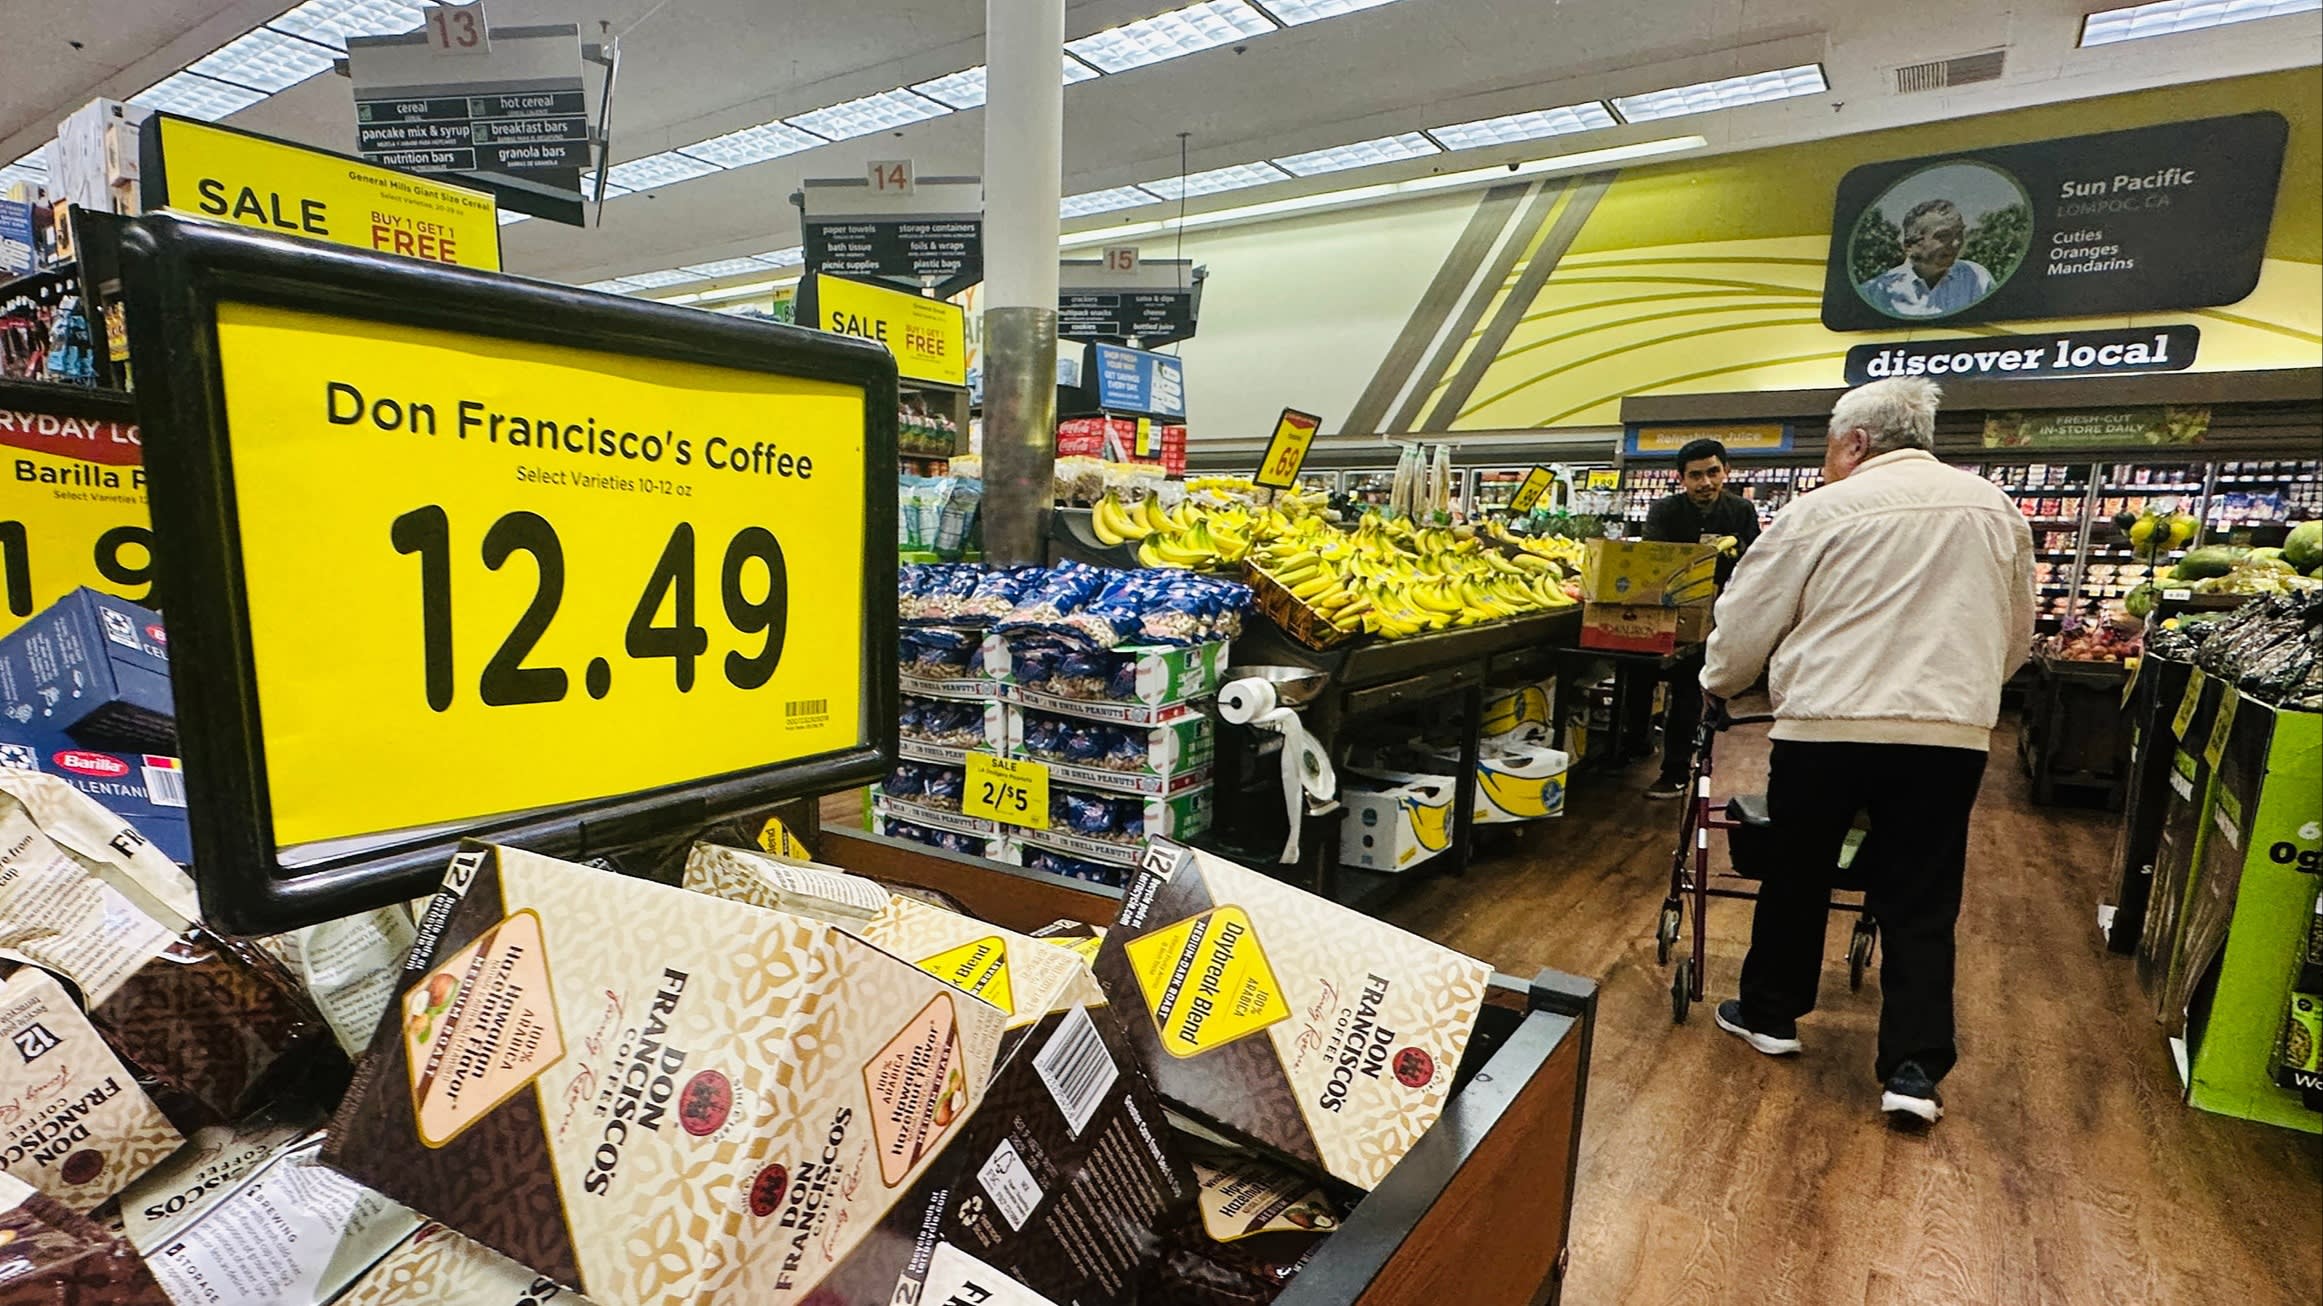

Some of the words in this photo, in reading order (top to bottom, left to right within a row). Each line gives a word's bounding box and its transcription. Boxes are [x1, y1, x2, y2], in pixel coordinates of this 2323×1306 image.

[433, 10, 479, 49] 13
[396, 101, 428, 114] cereal
[500, 96, 519, 109] hot
[521, 94, 555, 108] cereal
[362, 128, 405, 143] pancake
[407, 126, 428, 138] mix
[430, 126, 439, 137] &
[440, 124, 470, 140] syrup
[491, 121, 542, 136] breakfast
[544, 120, 568, 133] bars
[383, 151, 429, 165] nutrition
[431, 151, 454, 163] bars
[498, 147, 540, 162] granola
[541, 145, 566, 158] bars
[348, 170, 388, 188] General
[390, 178, 412, 193] Mills
[413, 184, 439, 200] Giant
[441, 190, 460, 204] Size
[462, 195, 491, 212] Cereal
[873, 163, 907, 191] 14
[2060, 180, 2107, 200] Sun
[2112, 167, 2197, 194] Pacific
[198, 178, 330, 236] SALE
[2144, 194, 2171, 211] CA
[371, 210, 401, 226] BUY
[406, 218, 413, 230] 1
[417, 219, 447, 235] GET
[449, 227, 455, 239] 1
[932, 223, 975, 232] containers
[2052, 229, 2103, 245] Cuties
[371, 225, 458, 264] FREE
[1107, 250, 1133, 270] 15
[2049, 243, 2119, 262] Oranges
[2046, 257, 2135, 276] Mandarins
[831, 310, 888, 343] SALE
[905, 333, 945, 357] FREE
[1866, 344, 2046, 379] discover
[2050, 334, 2169, 368] local
[326, 380, 436, 436] Don
[458, 399, 693, 466] Francisco's
[704, 437, 814, 480] Coffee
[2039, 423, 2104, 436] IN-STORE
[2106, 423, 2146, 435] DAILY
[14, 459, 120, 489] Barilla
[516, 464, 567, 487] Select
[570, 471, 636, 493] Varieties
[638, 477, 673, 496] 10-12
[676, 482, 693, 498] oz
[52, 489, 88, 502] Select
[90, 492, 137, 505] Varieties
[390, 504, 790, 713] 12.49
[1085, 706, 1124, 720] PEANUTS
[63, 754, 123, 773] Barilla
[992, 758, 1017, 772] SALE
[1098, 775, 1136, 788] PEANUTS
[982, 781, 1028, 811] 2/$5
[13, 834, 34, 857] from
[1147, 848, 1177, 875] 12
[450, 856, 478, 887] 12
[1119, 872, 1151, 927] terracycle.com
[1142, 877, 1162, 905] Recycle
[432, 896, 457, 933] Recycle
[1135, 903, 1149, 921] pods
[405, 892, 449, 971] terracycle.com
[420, 933, 438, 957] pods
[956, 944, 991, 979] Blend
[1198, 921, 1245, 996] Daybreak
[450, 955, 486, 1021] MEDIUM
[475, 945, 525, 1032] Hazelnut
[1157, 988, 1180, 1019] ROAST
[1233, 977, 1260, 1018] ARABICA
[1251, 990, 1270, 1016] 100%
[471, 984, 524, 1079] Hawaiian
[1178, 993, 1214, 1046] Blend
[1323, 1008, 1352, 1064] COFFEE
[15, 1025, 56, 1058] 12
[500, 1008, 536, 1071] ARABICA
[520, 1024, 545, 1063] 100%
[1319, 972, 1391, 1113] FRANCISCO'S
[1360, 1025, 1396, 1080] DON
[446, 1036, 483, 1100] Flavor
[584, 967, 690, 1197] FRANCISCO'S
[594, 1027, 638, 1118] COFFEE
[890, 1045, 923, 1123] Hawaiian
[637, 1046, 688, 1132] DON
[891, 1083, 923, 1155] Hazelnut
[917, 1026, 939, 1078] Flavor
[8, 1098, 69, 1141] COFFEE
[33, 1124, 92, 1168] DON
[774, 1106, 853, 1291] FRANCISCO'S
[779, 1160, 816, 1228] DON
[813, 1163, 844, 1237] COFFEE
[255, 1192, 298, 1245] BREWING
[915, 1189, 949, 1274] terracycle.com
[908, 1230, 928, 1271] Recycle
[922, 1204, 936, 1229] pods
[175, 1252, 222, 1305] STORAGE
